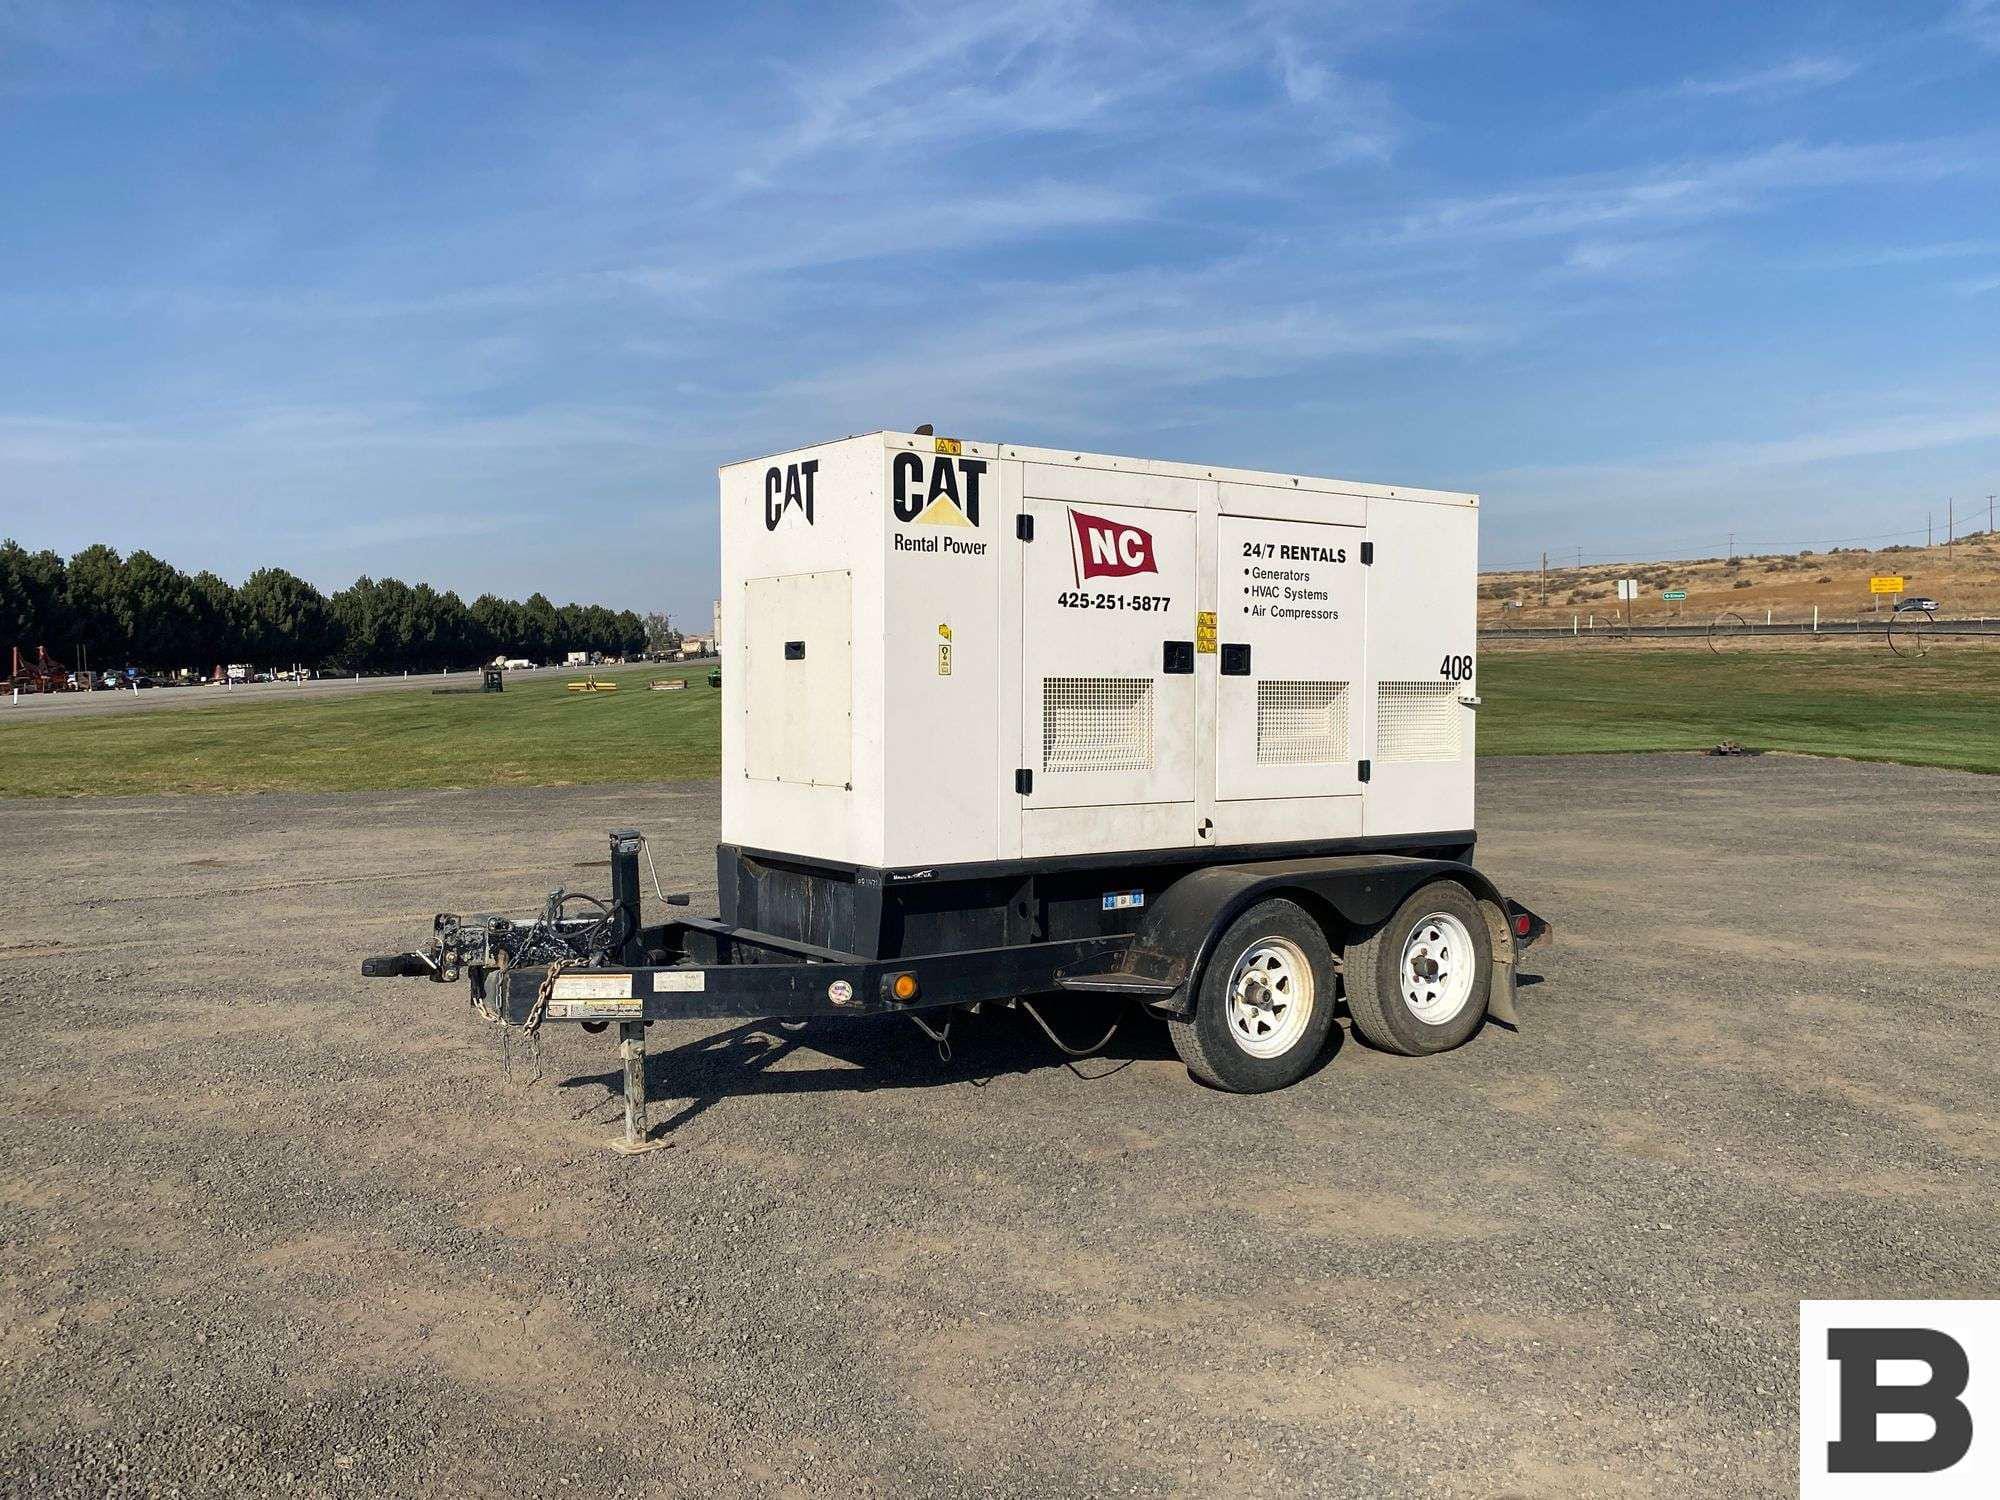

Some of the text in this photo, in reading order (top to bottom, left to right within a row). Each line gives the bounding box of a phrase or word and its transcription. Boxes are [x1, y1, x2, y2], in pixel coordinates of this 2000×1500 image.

[766, 459, 819, 531] CAT
[893, 451, 987, 527] CAT
[894, 533, 987, 555] Rental Power
[1087, 527, 1145, 568] NC
[1242, 542, 1346, 563] 24/7 RENTALS
[1252, 566, 1310, 582] Generators
[1058, 592, 1170, 612] 425-251-5877
[1251, 585, 1328, 601] HVAC Systems
[1251, 604, 1339, 620] Air Compressors
[1439, 654, 1473, 681] 408
